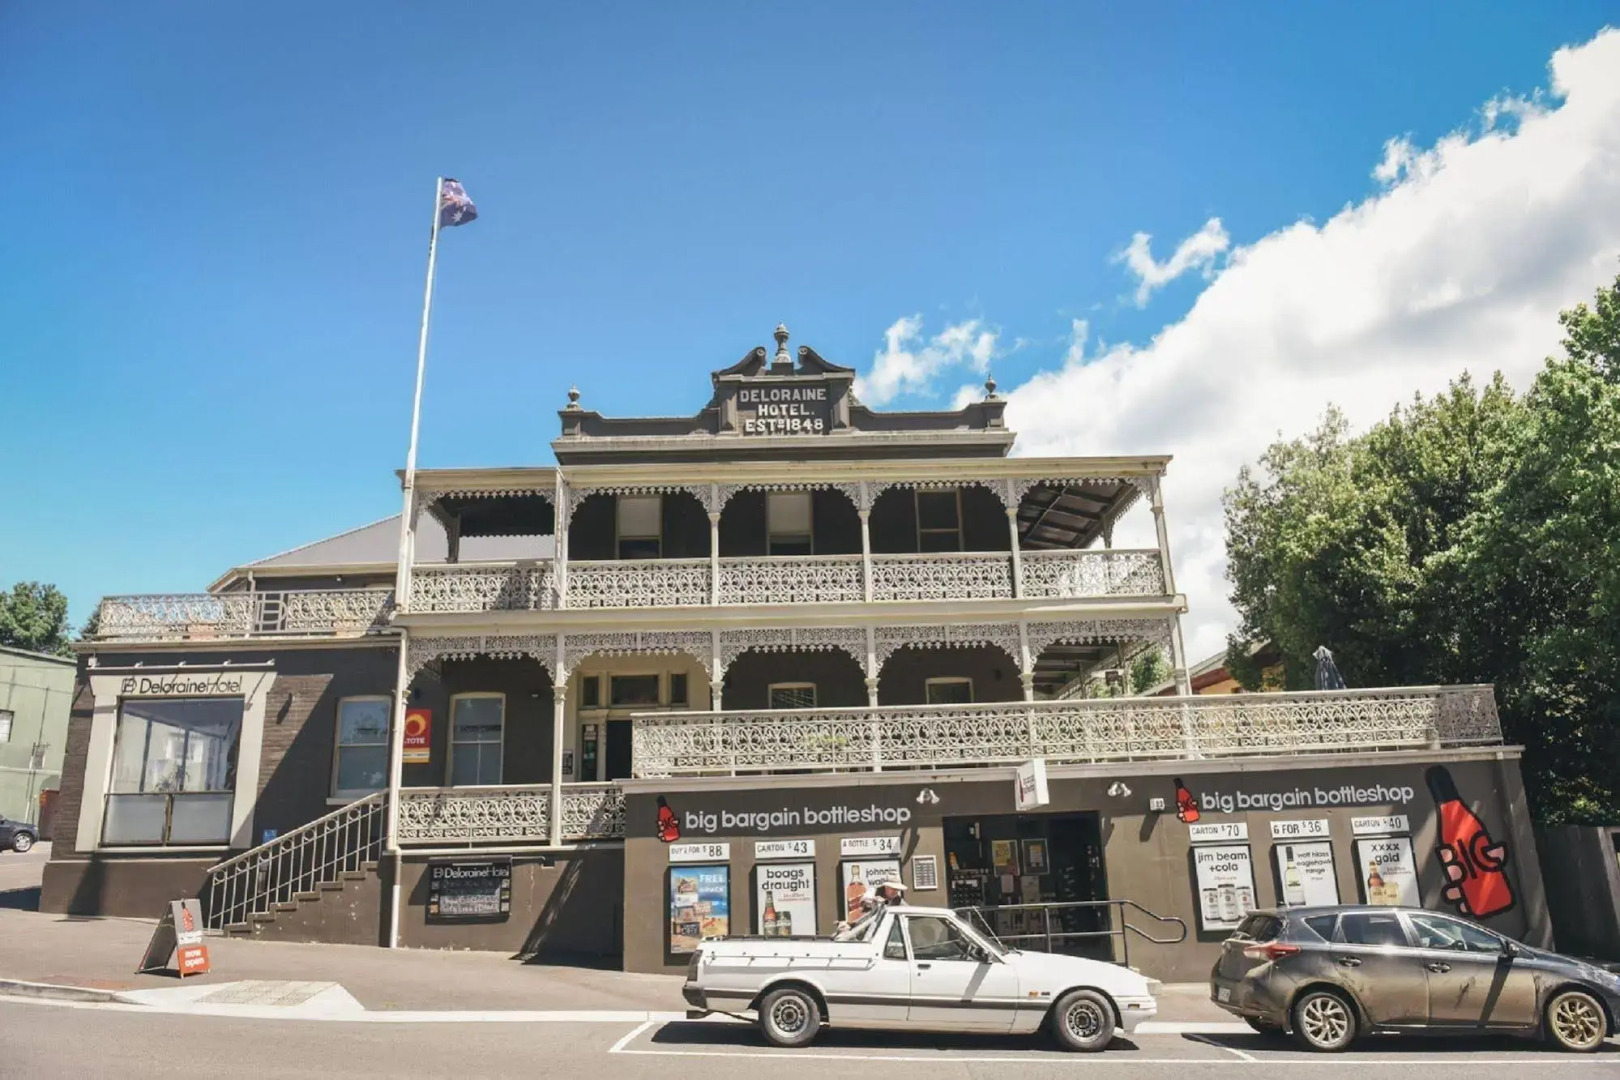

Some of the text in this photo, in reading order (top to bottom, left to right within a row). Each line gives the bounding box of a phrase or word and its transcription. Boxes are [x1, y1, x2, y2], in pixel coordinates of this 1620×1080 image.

[740, 388, 827, 402] DELORAINE
[1202, 783, 1414, 813] big bargain bottleshop
[686, 804, 911, 833] big bargain bottleshop
[1273, 825, 1280, 834] 6
[1282, 824, 1300, 834] FOR
[1354, 819, 1380, 829] CARTON
[1192, 826, 1218, 835] CARTON
[757, 844, 785, 853] CARTON
[848, 839, 868, 848] BOTTLE
[1198, 851, 1248, 863] jim beam
[1375, 852, 1400, 865] gold
[1209, 862, 1239, 872] +cola
[1305, 867, 1326, 875] range
[700, 874, 725, 883] FREE
[766, 869, 804, 880] boags
[761, 879, 810, 891] draught
